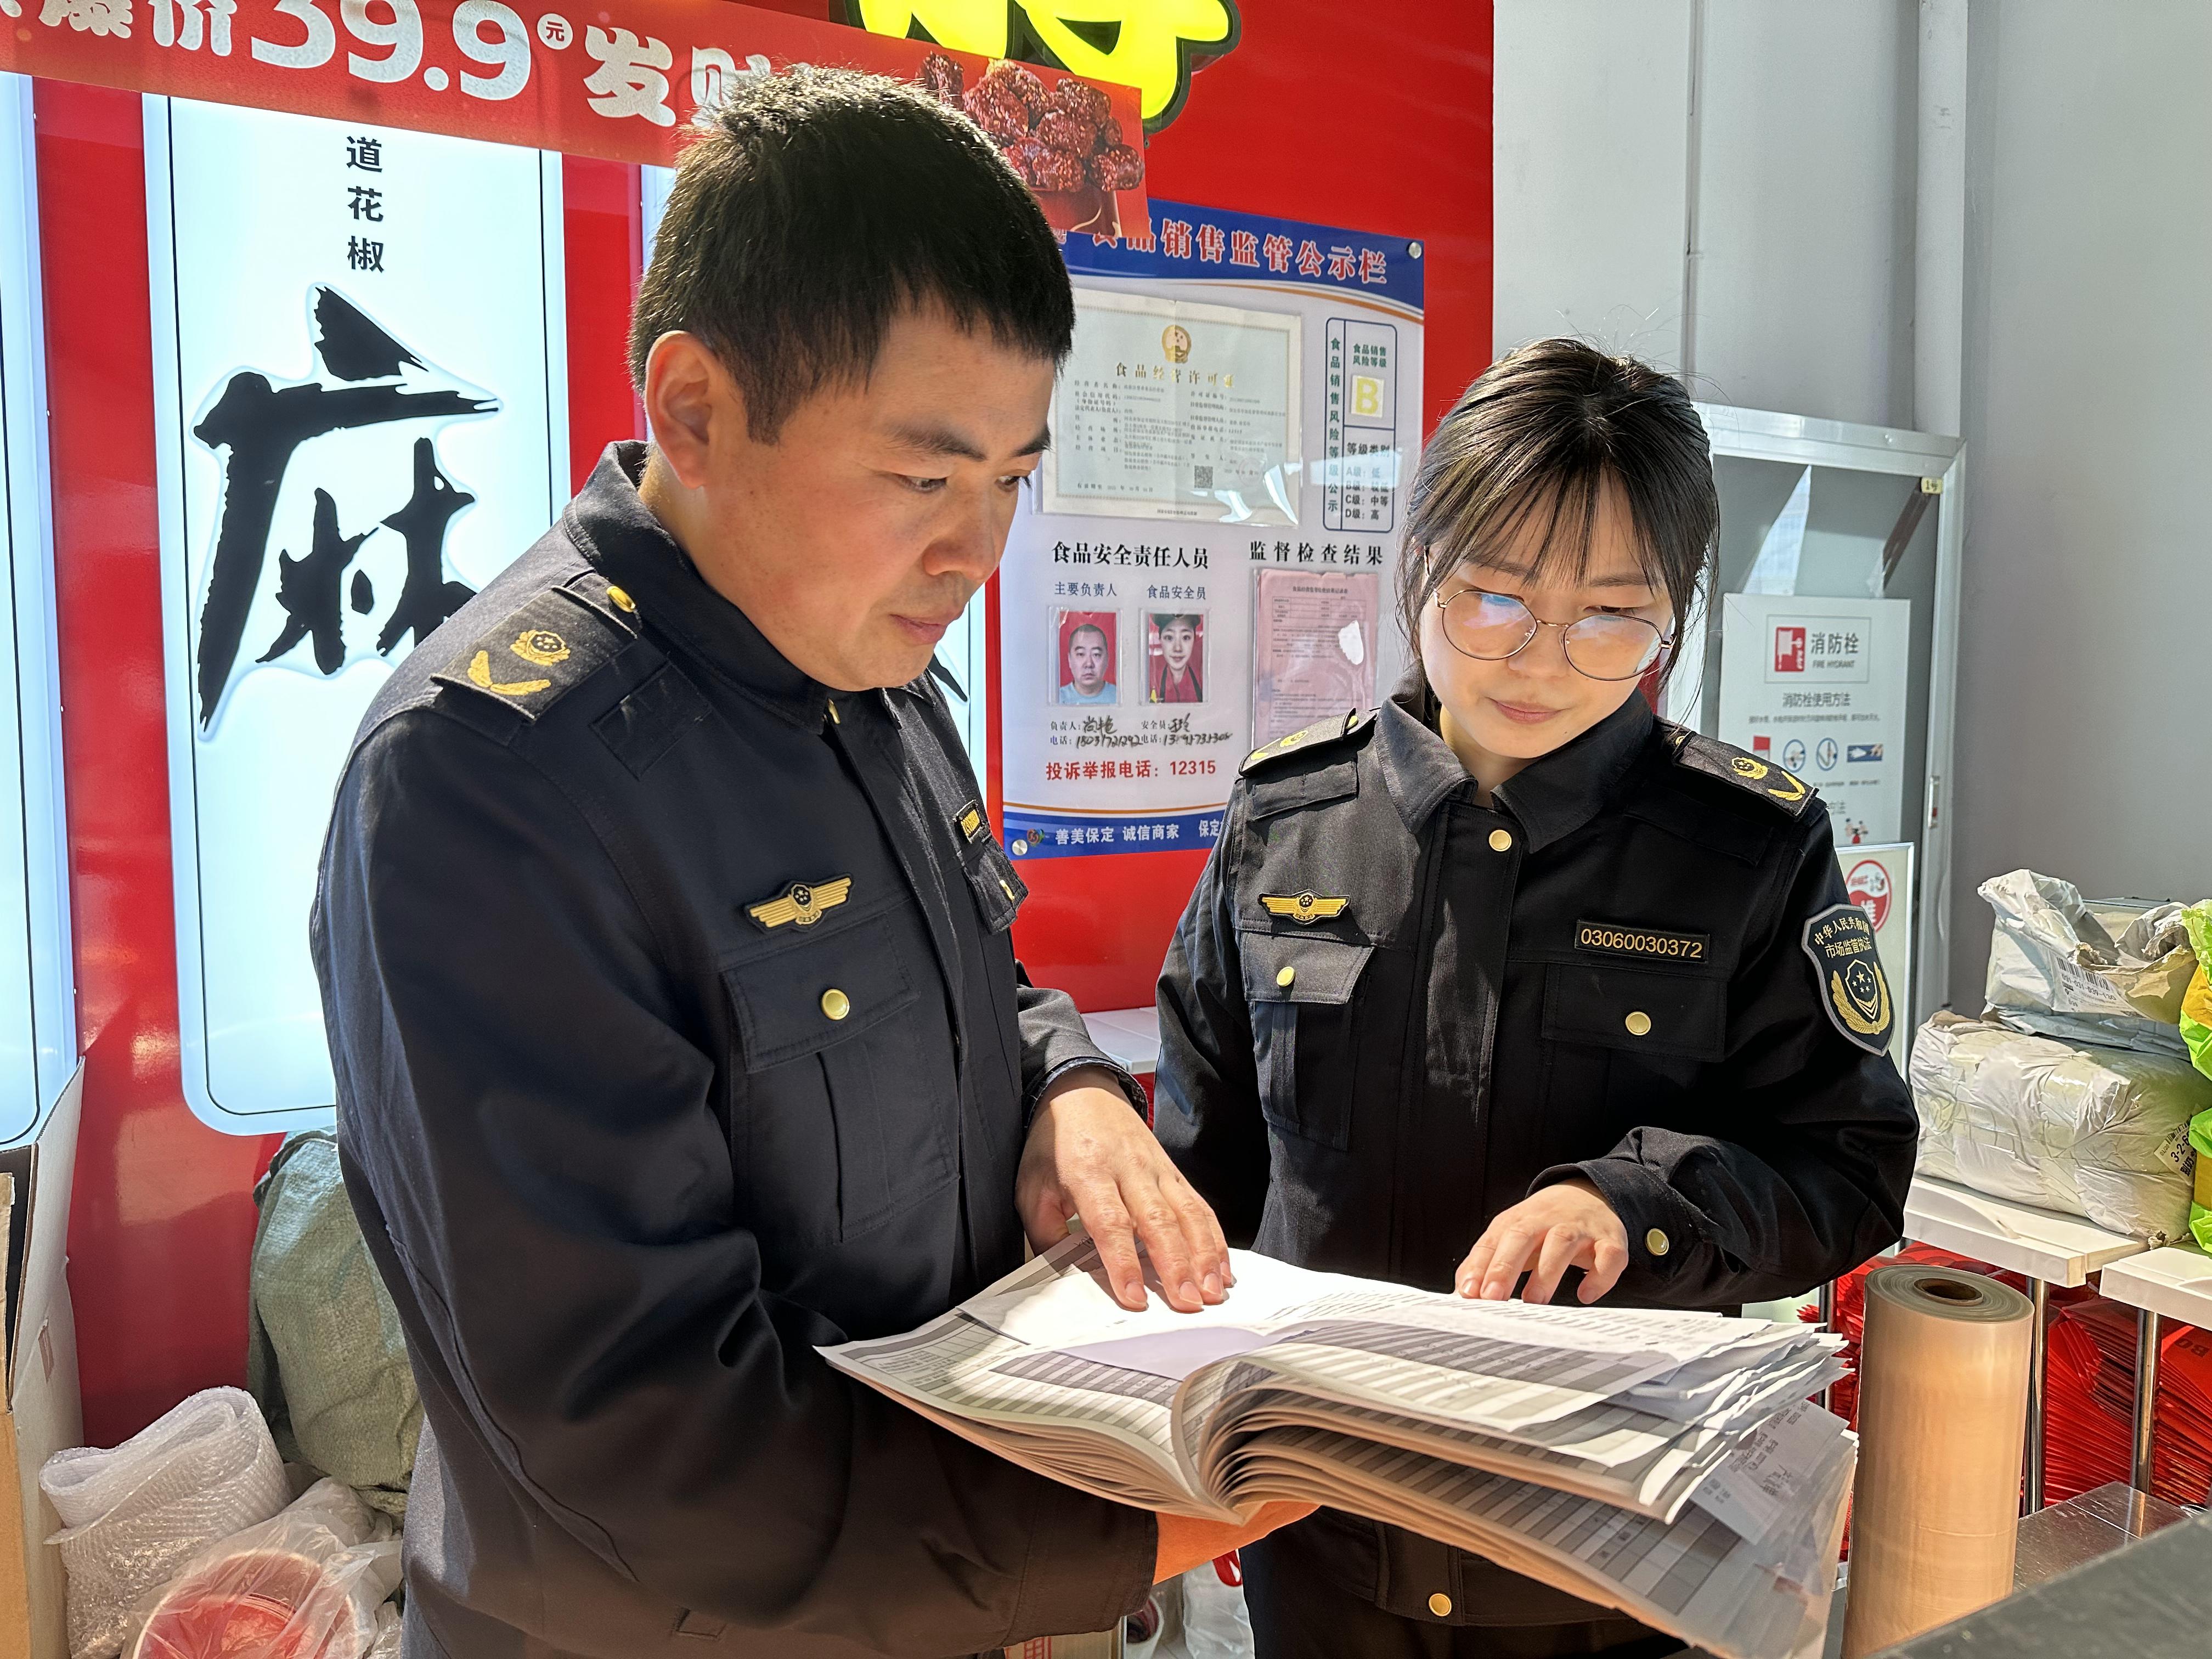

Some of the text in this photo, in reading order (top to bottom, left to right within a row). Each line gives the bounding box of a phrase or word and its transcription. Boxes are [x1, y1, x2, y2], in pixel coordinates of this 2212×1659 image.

[347, 136, 385, 273] 道花椒
[1092, 218, 1388, 285] 销售监管公示栏
[1352, 356, 1387, 368] 风险等级
[1353, 343, 1387, 357] 食品销售
[1355, 377, 1379, 415] B
[1328, 337, 1340, 511] 食品销售风险等级公示
[1347, 442, 1390, 458] 等级类别
[1052, 541, 1209, 569] 食品安全责任人员
[1250, 541, 1384, 566] 监督检查结果
[1054, 581, 1118, 597] 主要负责人
[1147, 584, 1206, 600] 食品安全员
[1811, 632, 1859, 654] 消防栓
[1056, 819, 1223, 845] 善美保定 诚信商家 保定
[1581, 928, 1702, 958] 03060030372
[1814, 916, 1870, 946] 中华人民共和国
[1824, 935, 1872, 959] 市场监管执法
[2171, 1131, 2190, 1163] 3-2-6
